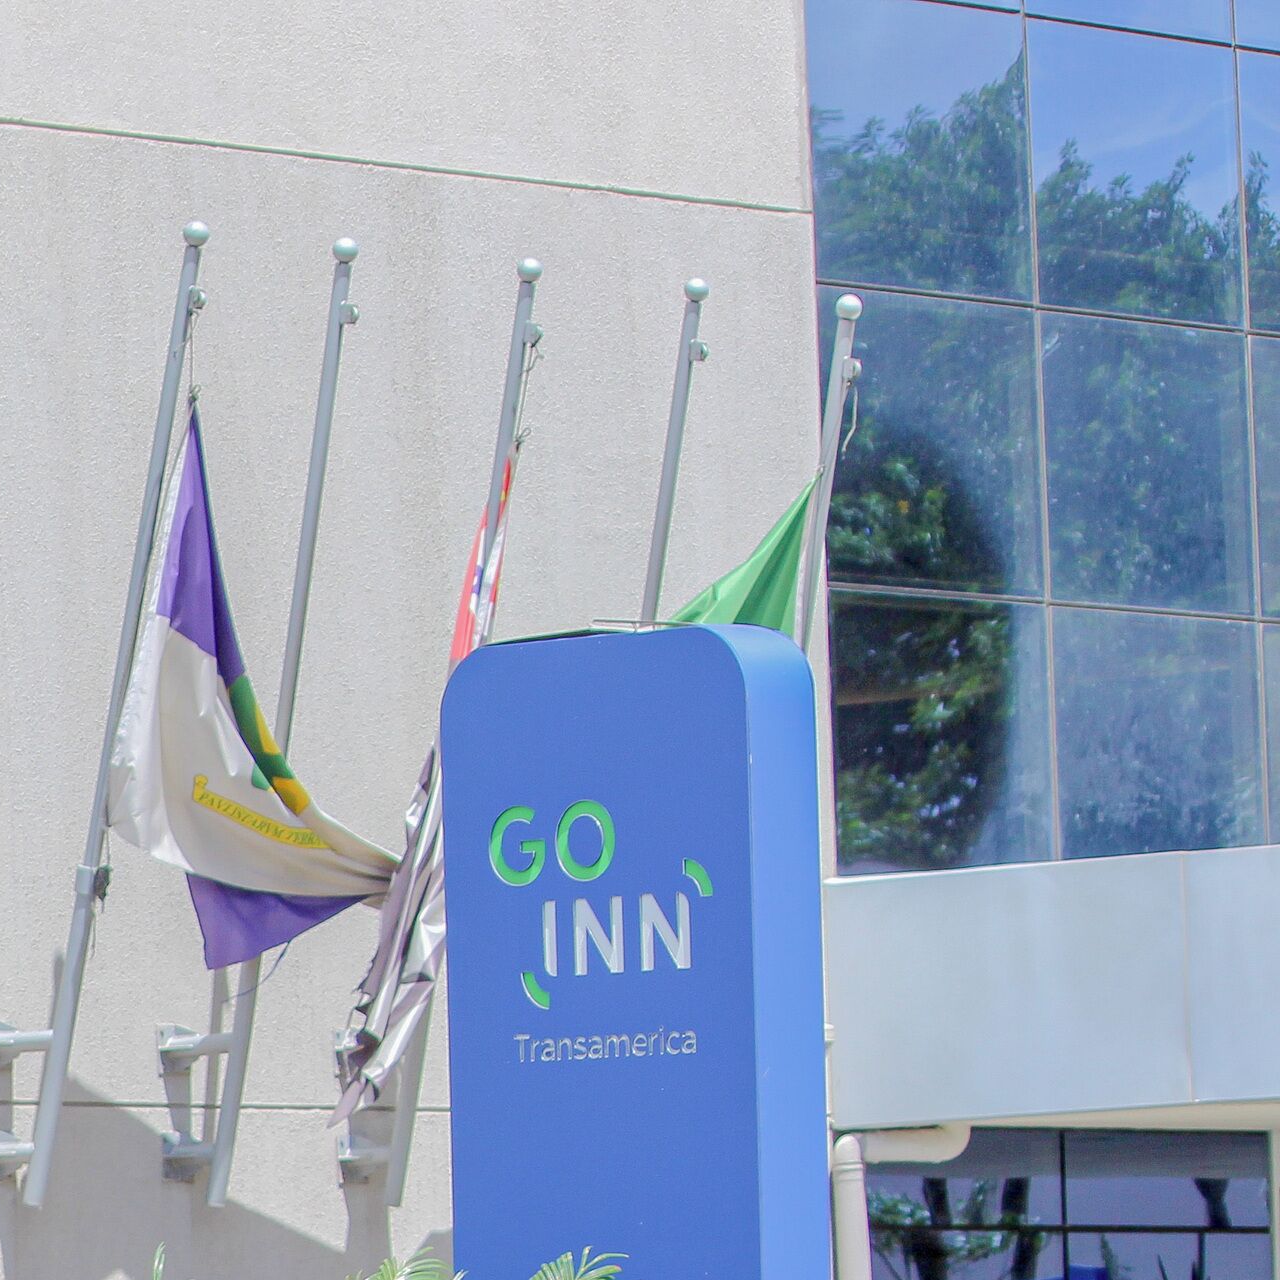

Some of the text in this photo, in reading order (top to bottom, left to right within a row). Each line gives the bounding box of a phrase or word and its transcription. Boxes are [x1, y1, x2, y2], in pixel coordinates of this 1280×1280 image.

[488, 799, 616, 888] GO
[542, 891, 692, 977] INN
[513, 1024, 698, 1064] Transamerica
